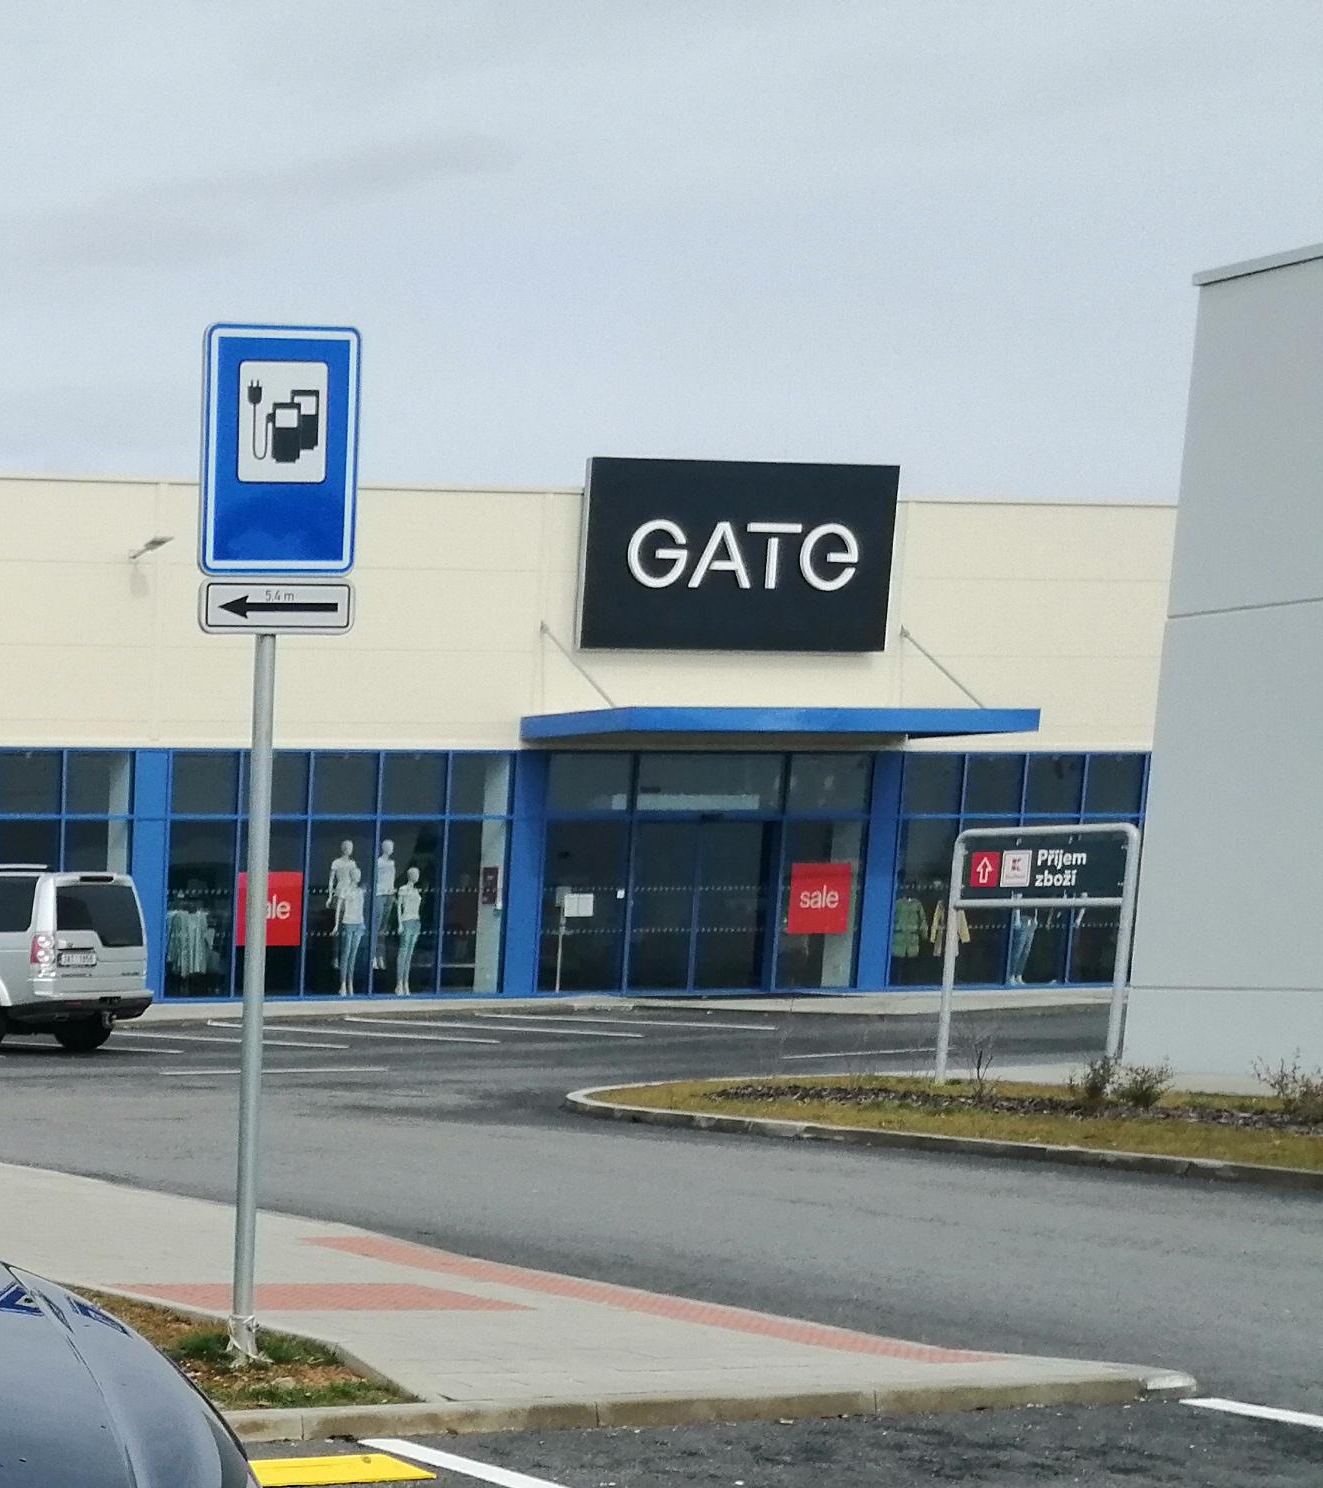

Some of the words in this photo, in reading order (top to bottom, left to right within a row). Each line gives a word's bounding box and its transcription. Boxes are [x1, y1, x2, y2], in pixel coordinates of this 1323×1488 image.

[283, 592, 295, 601] m
[1037, 848, 1087, 869] Příjem
[1035, 869, 1077, 887] zboží
[266, 893, 291, 920] le
[799, 884, 839, 909] sale
